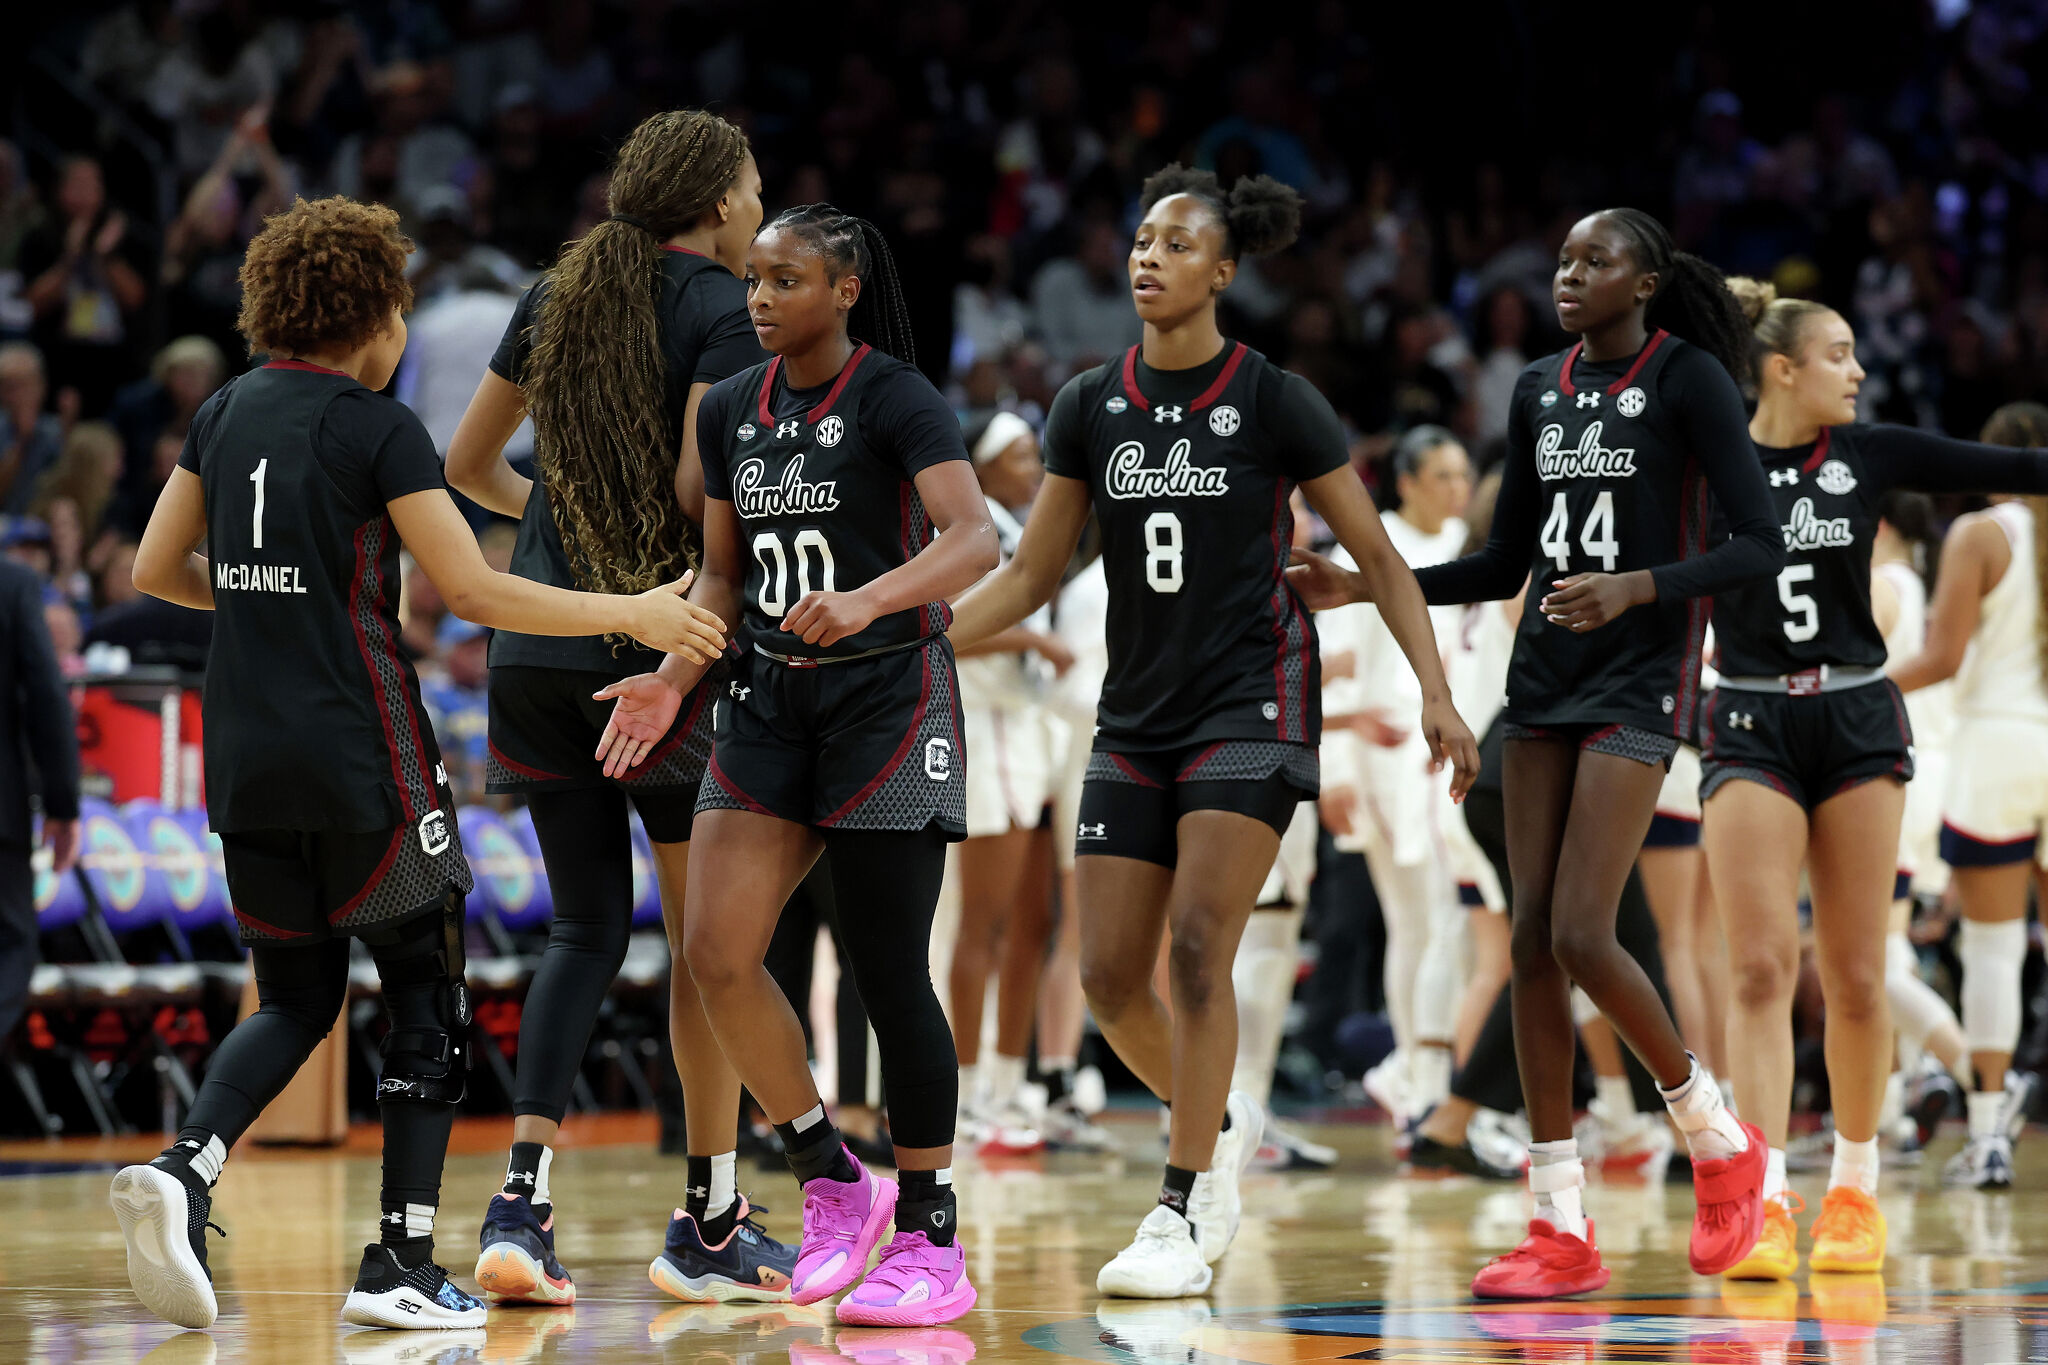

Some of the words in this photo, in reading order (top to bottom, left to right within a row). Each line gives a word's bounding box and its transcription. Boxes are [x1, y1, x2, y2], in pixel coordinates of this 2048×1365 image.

[817, 417, 842, 446] SEC
[1210, 407, 1239, 435] SEC
[1618, 388, 1645, 415] SEC
[1105, 438, 1230, 500] Carolina
[1535, 420, 1638, 481] Carolina
[249, 458, 268, 549] 1
[733, 453, 840, 519] Carolina
[1144, 512, 1184, 593] 8
[1540, 491, 1619, 572] 44
[1781, 496, 1855, 552] olina
[217, 562, 308, 594] McDANIEL
[753, 529, 835, 617] 00
[1776, 563, 1820, 643] 5
[379, 1081, 414, 1091] ONJOY
